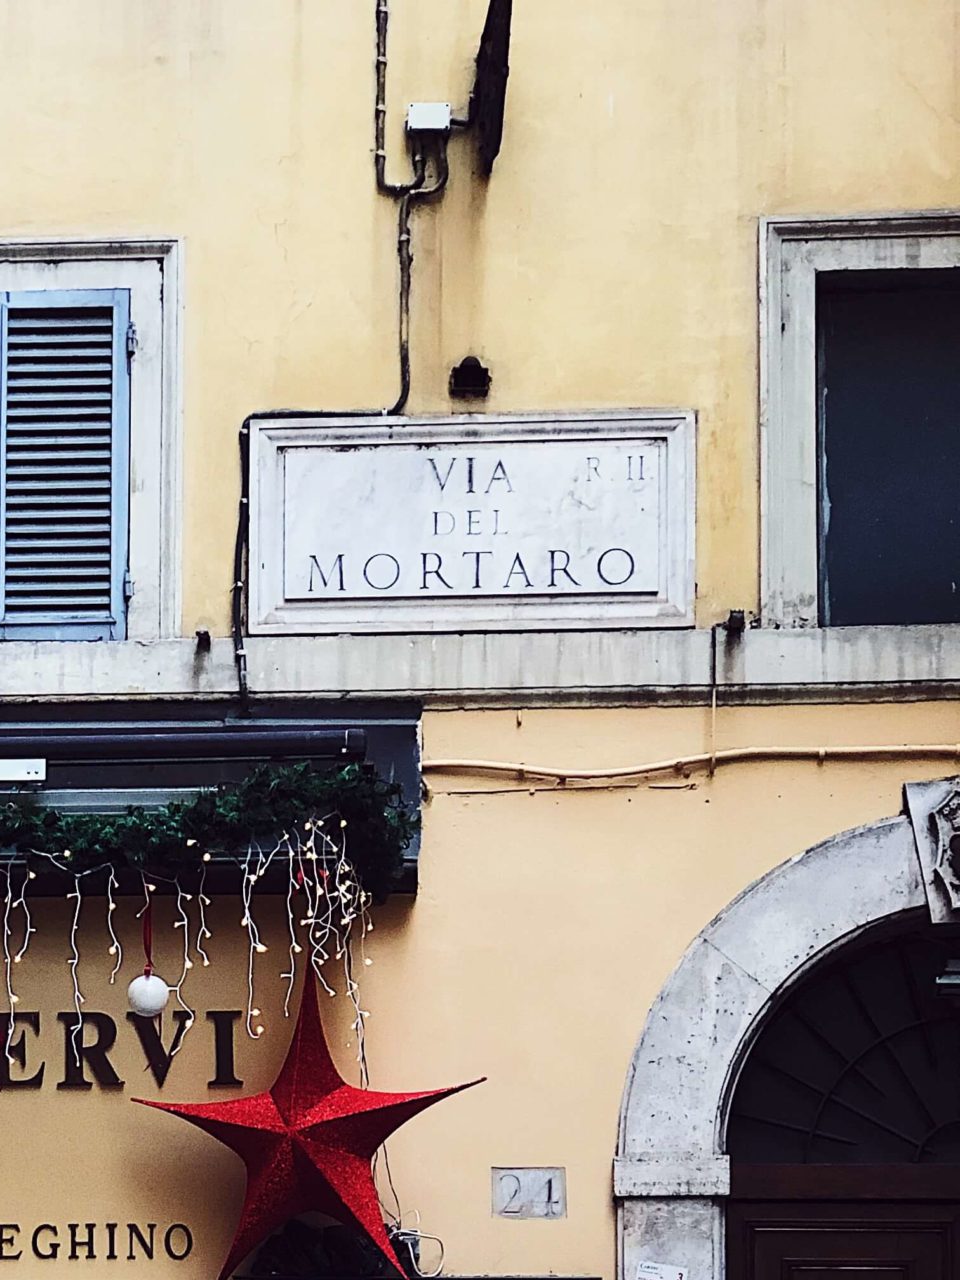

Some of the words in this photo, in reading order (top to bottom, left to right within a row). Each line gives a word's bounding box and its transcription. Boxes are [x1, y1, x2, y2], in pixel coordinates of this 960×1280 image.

[428, 456, 513, 494] VIA
[433, 509, 509, 536] DEL
[308, 547, 636, 592] MORTARO
